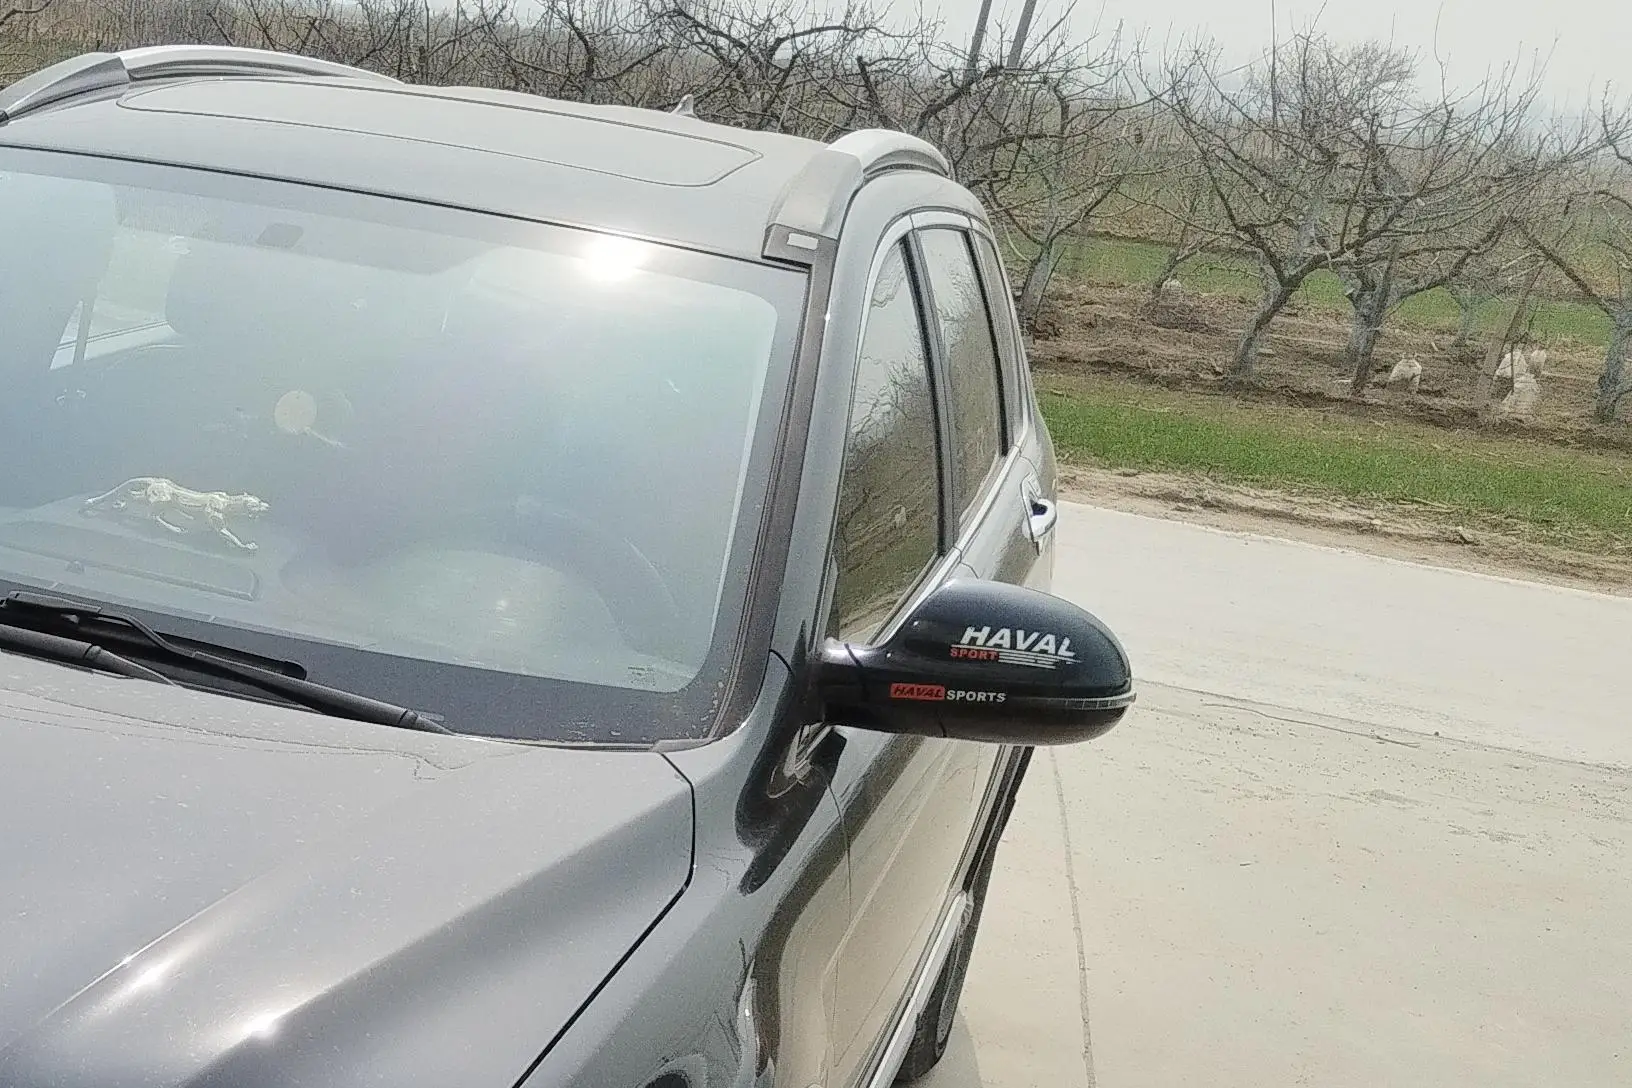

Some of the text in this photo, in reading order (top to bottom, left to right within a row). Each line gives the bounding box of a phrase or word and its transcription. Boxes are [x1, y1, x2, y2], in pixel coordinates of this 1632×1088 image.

[960, 625, 1076, 657] HAVAL
[950, 647, 999, 661] SPORT
[893, 684, 1007, 703] HAVAL SPORTS
